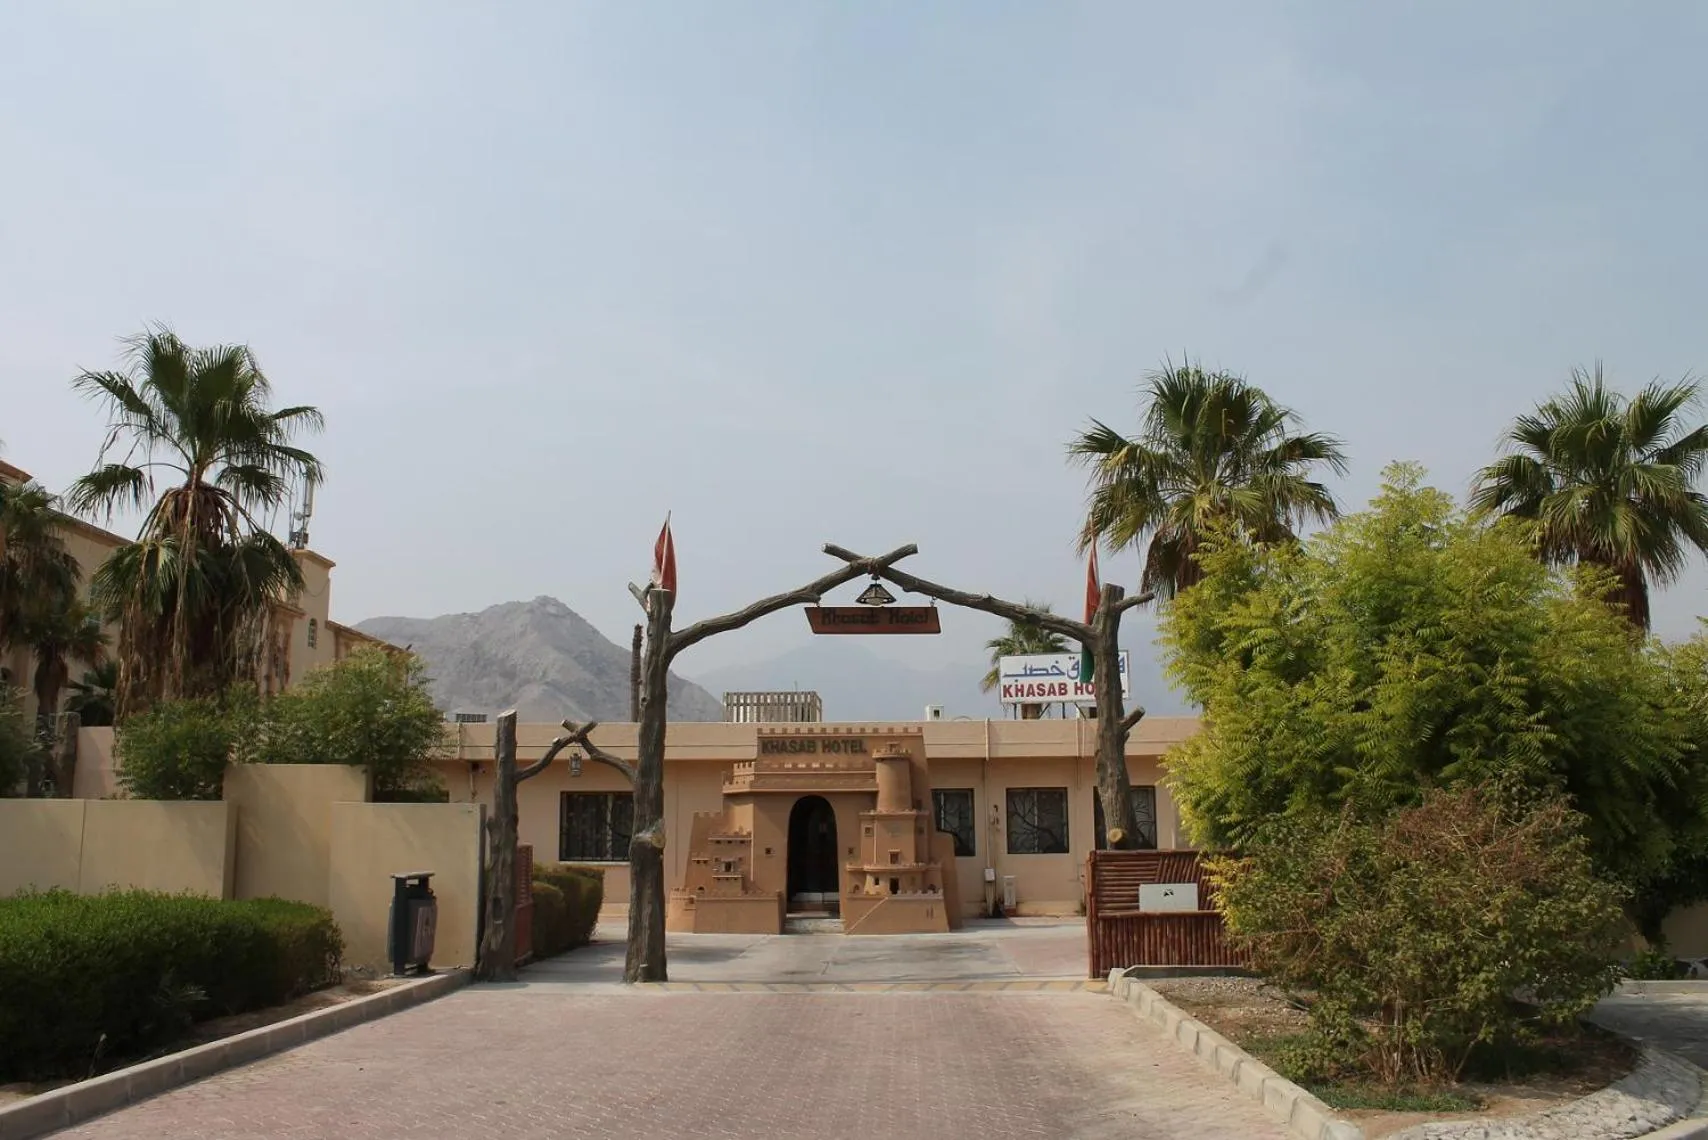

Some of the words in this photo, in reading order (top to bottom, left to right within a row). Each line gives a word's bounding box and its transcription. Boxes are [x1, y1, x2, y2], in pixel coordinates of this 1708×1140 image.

[1002, 660, 1066, 682] خصب
[1003, 682, 1068, 698] KHASAB
[762, 739, 817, 754] KHASAB
[822, 739, 867, 754] HOTEL
